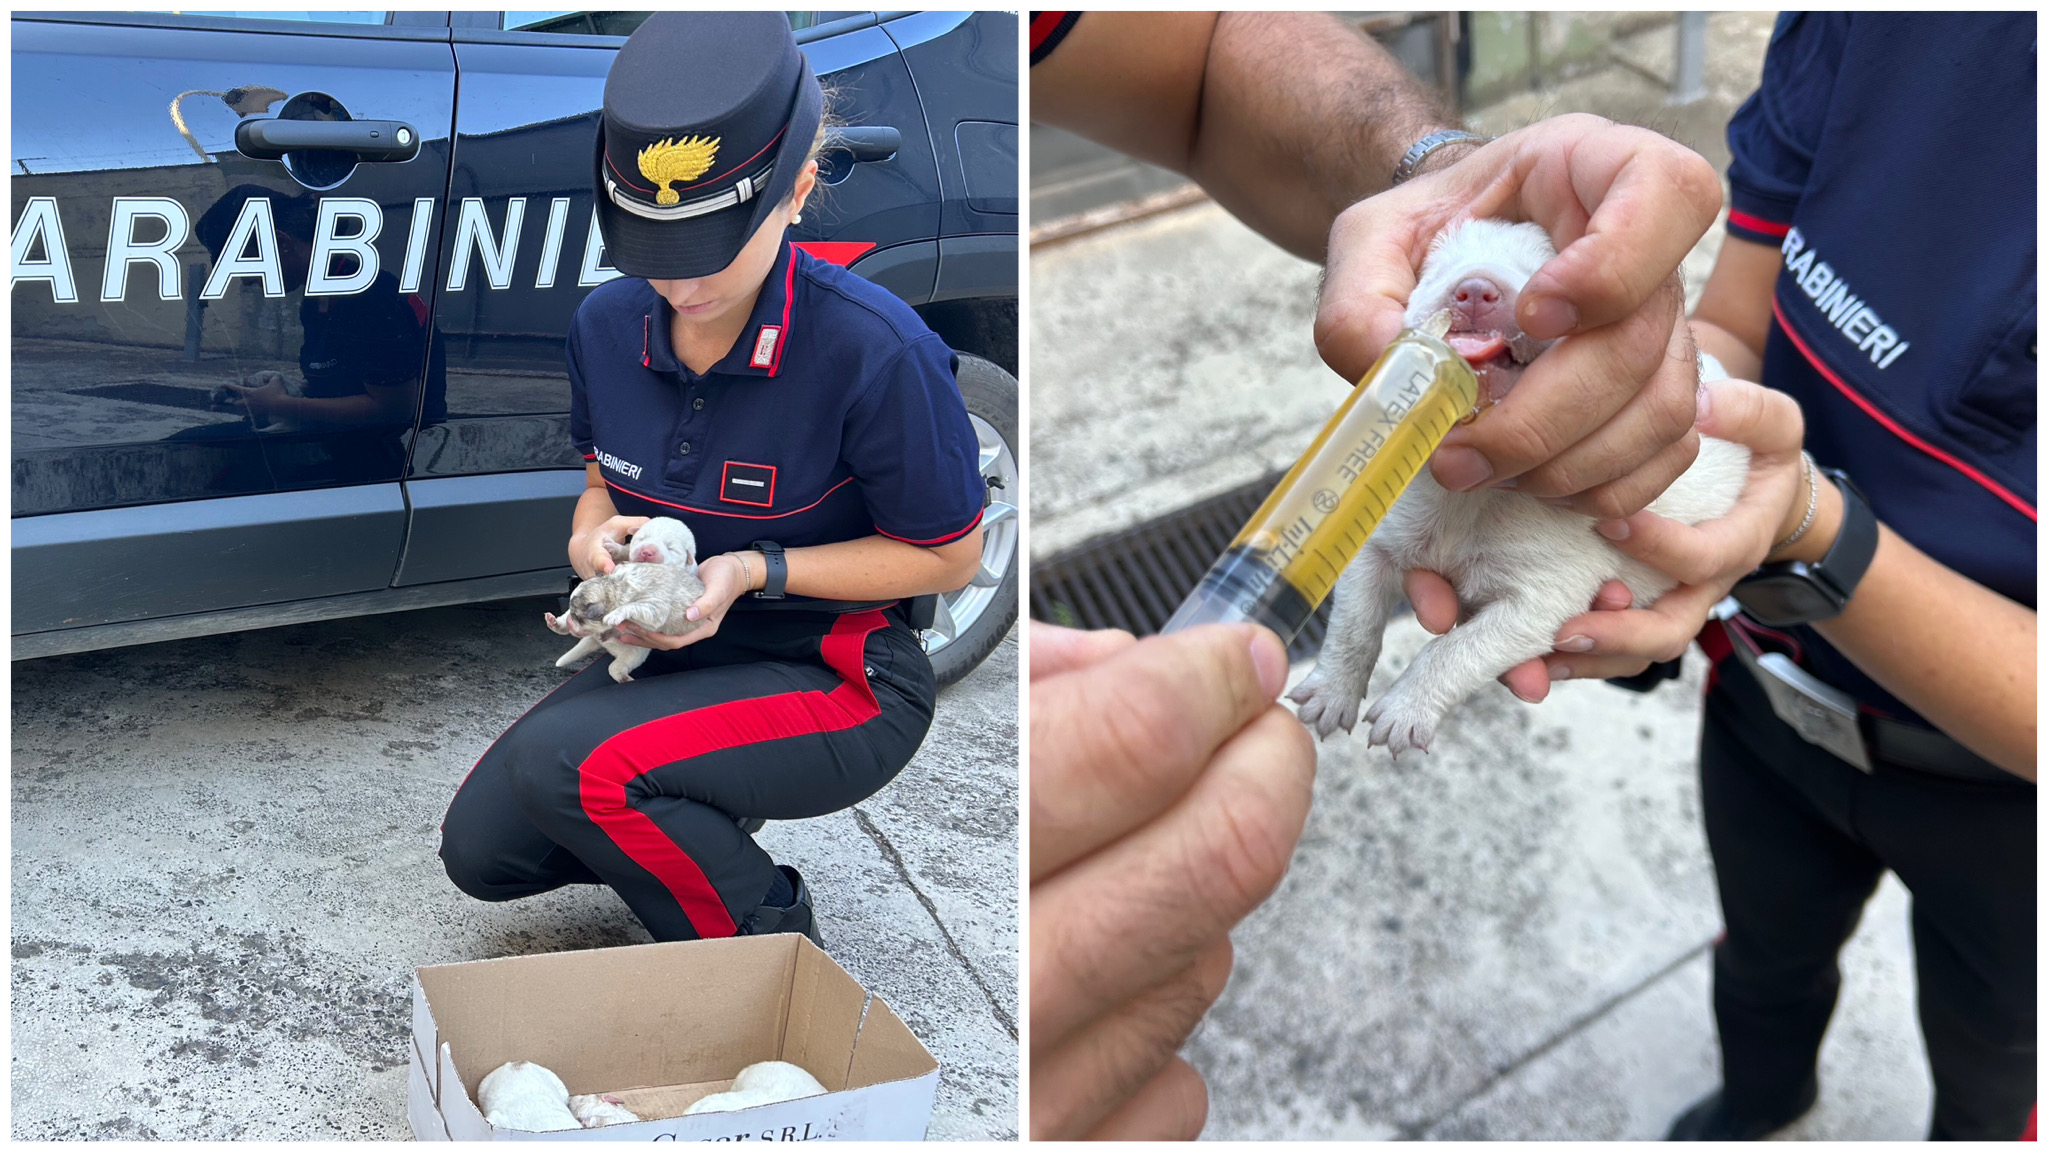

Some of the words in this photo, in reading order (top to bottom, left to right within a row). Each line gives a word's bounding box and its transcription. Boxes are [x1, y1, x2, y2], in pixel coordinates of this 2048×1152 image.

[1781, 226, 1910, 370] RABINIERI
[1377, 370, 1431, 432] LATEX
[1336, 428, 1386, 484] FREE
